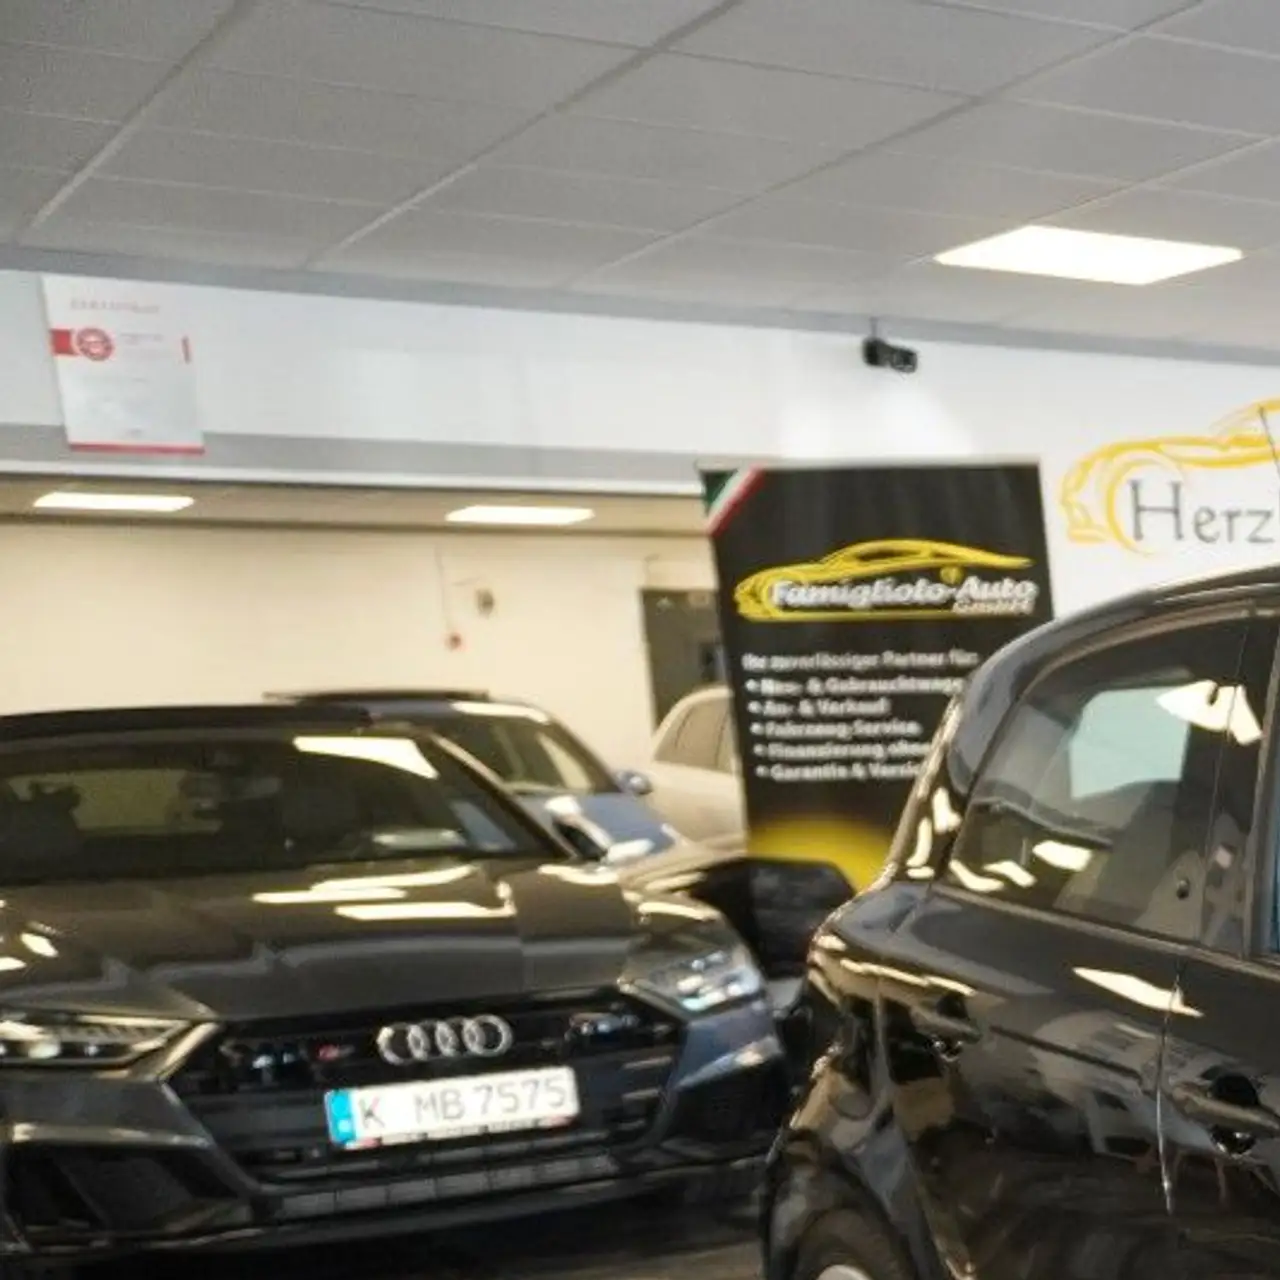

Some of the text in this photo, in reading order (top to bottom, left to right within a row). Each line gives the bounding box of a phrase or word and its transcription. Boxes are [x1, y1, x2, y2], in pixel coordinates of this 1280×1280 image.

[357, 1074, 568, 1130] K MB 7575
